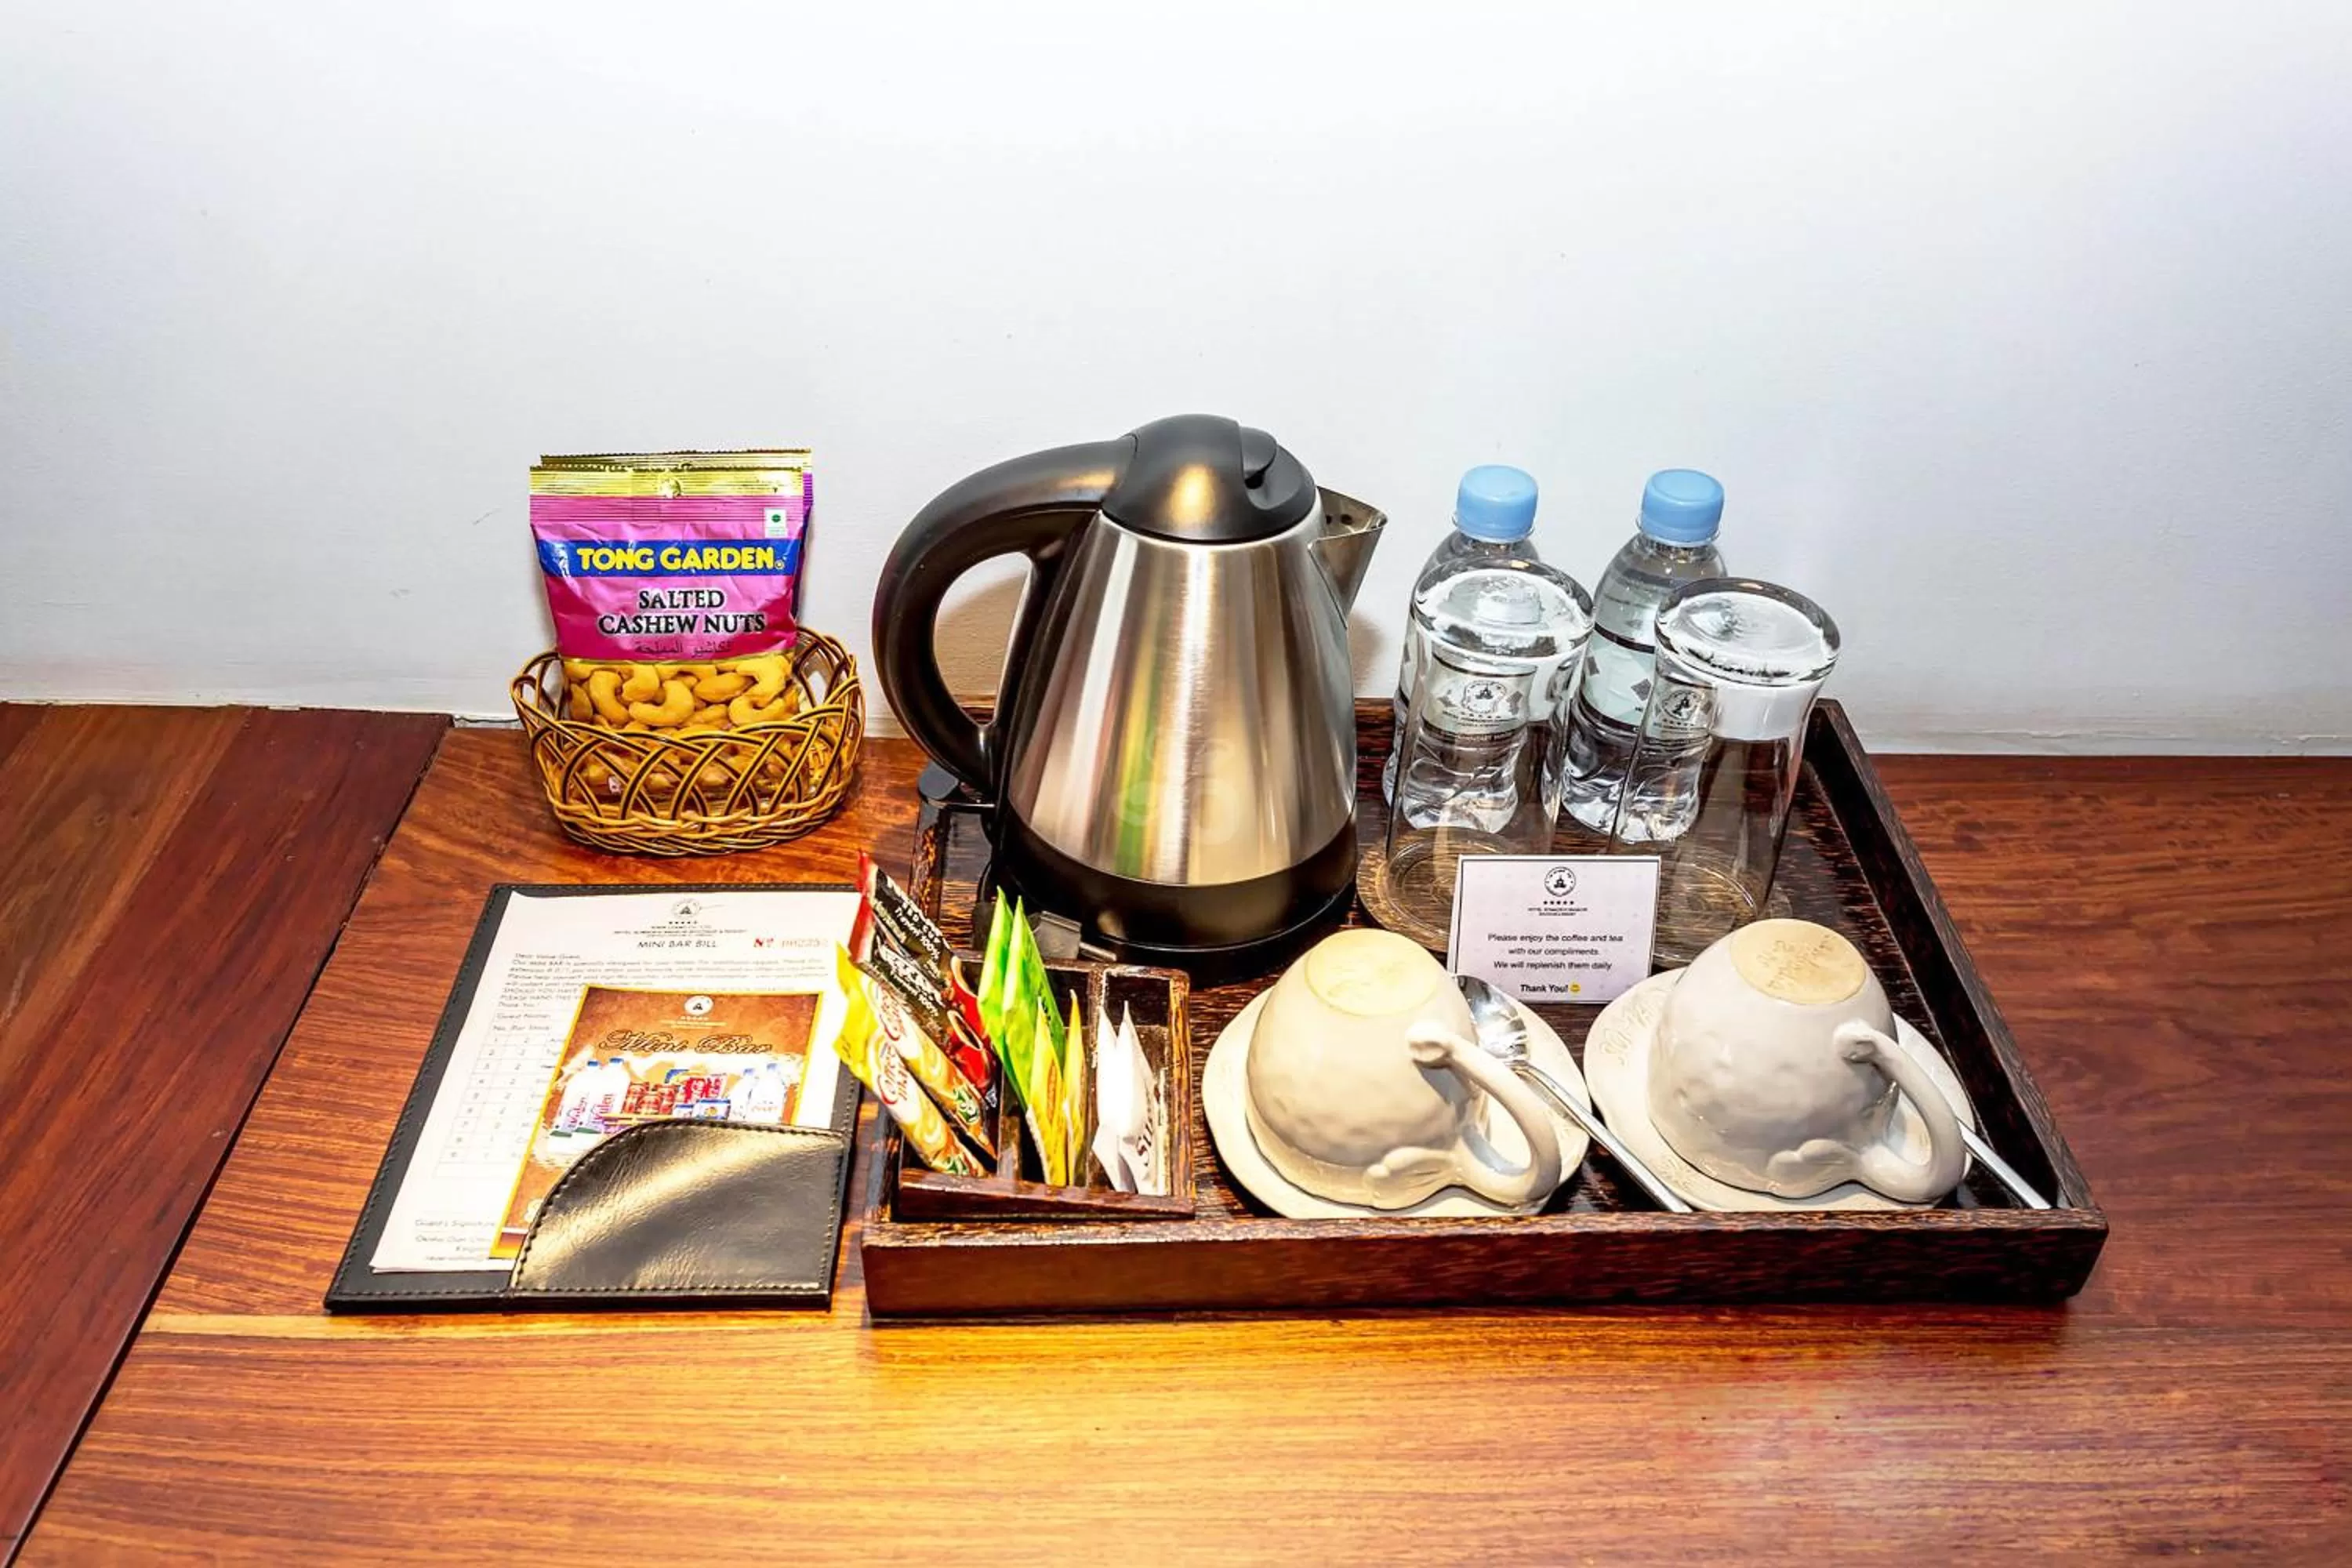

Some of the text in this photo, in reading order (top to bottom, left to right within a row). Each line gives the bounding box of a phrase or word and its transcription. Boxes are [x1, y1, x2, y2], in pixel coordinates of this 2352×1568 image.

[576, 546, 775, 571] TONG GARDEN
[639, 590, 725, 609] SALTED
[598, 614, 765, 634] CASHEW NUTS
[637, 940, 717, 949] MINI BAR BILL
[1519, 935, 1543, 943] enjoy
[1494, 960, 1613, 972] We will replenish them daily
[1520, 984, 1569, 993] Thank You!
